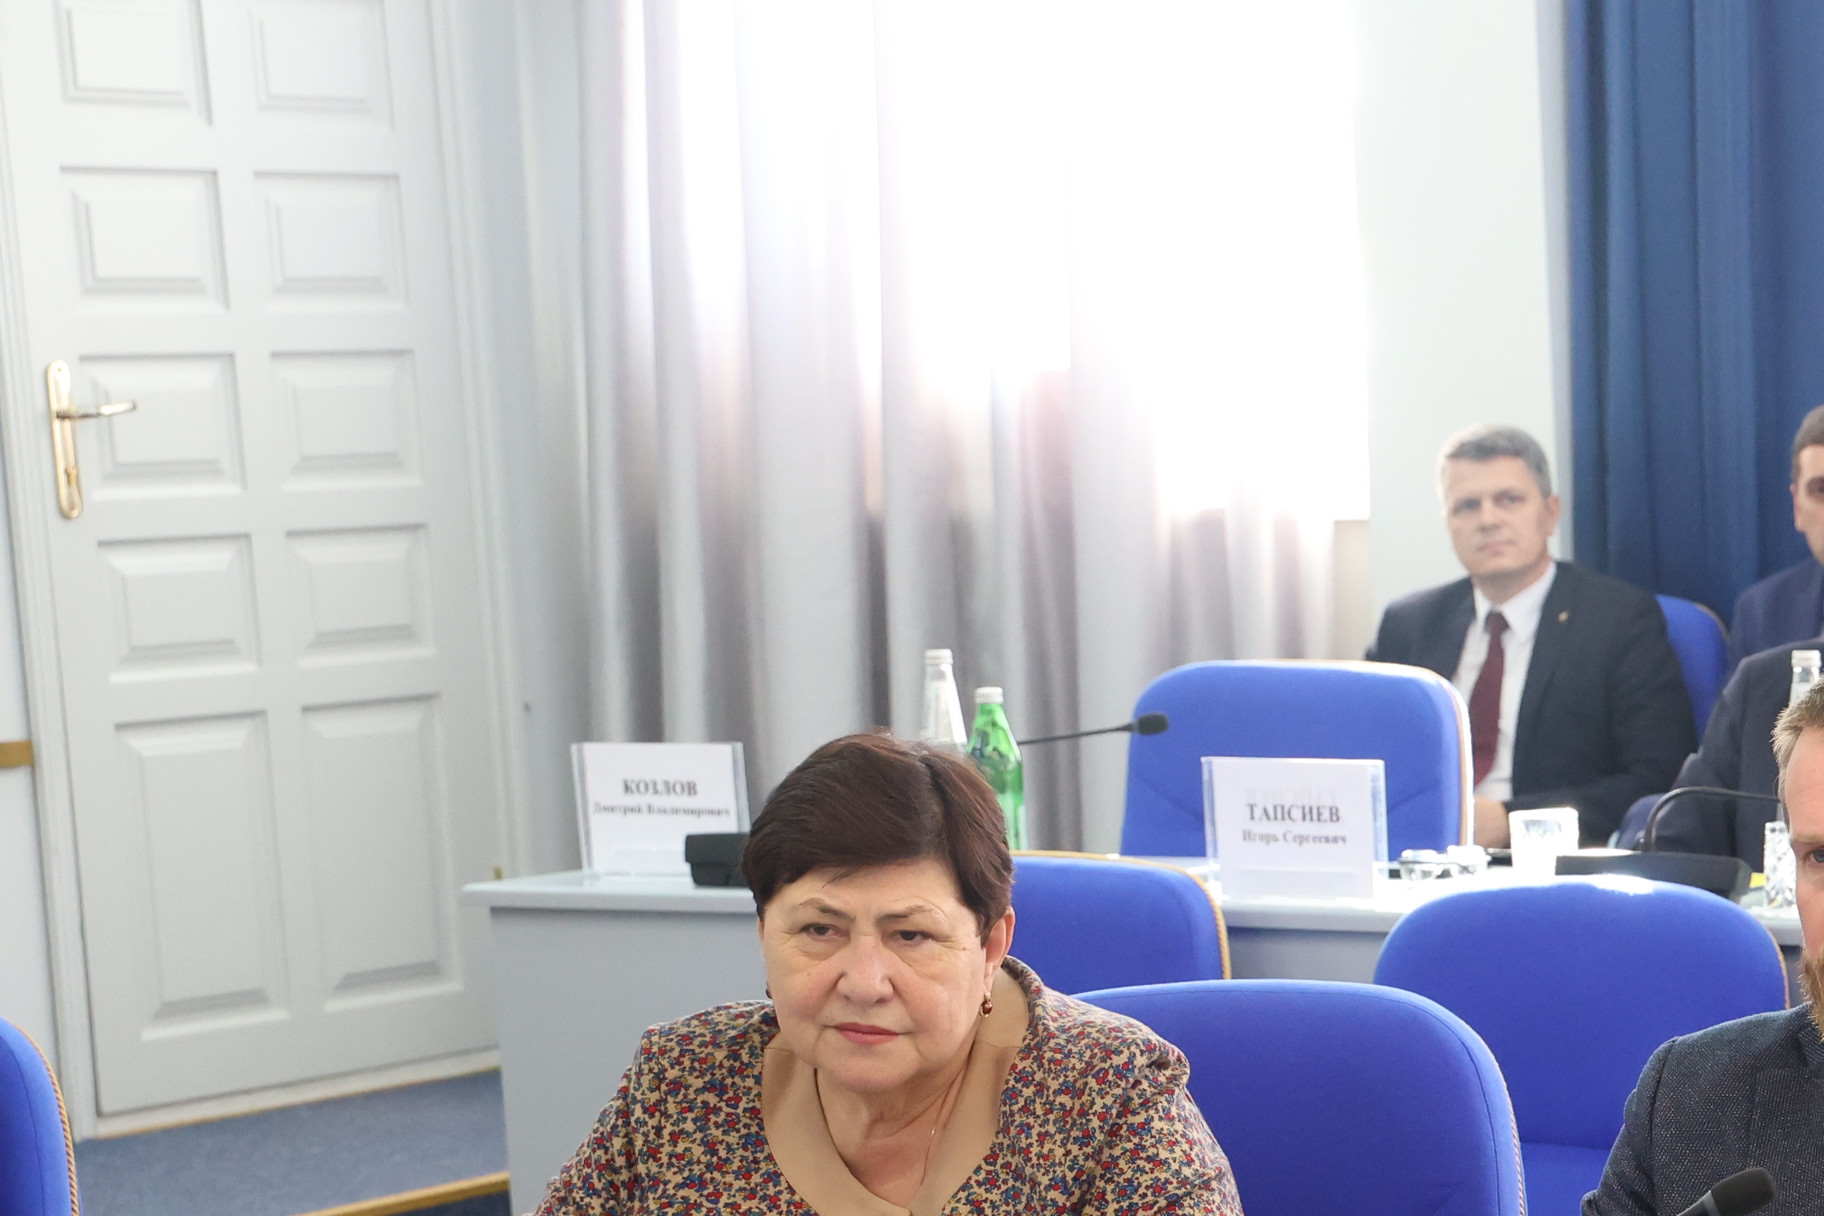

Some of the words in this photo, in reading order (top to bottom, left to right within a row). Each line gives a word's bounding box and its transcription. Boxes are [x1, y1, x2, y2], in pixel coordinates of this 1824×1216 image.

[622, 778, 698, 796] КОЗЛОВ
[593, 801, 643, 818] Дмитрий
[647, 803, 730, 818] Владимирович
[1245, 803, 1341, 823] ТАПСИЕВ
[1242, 829, 1279, 845] Игорь
[1282, 830, 1347, 846] Сергеевич
